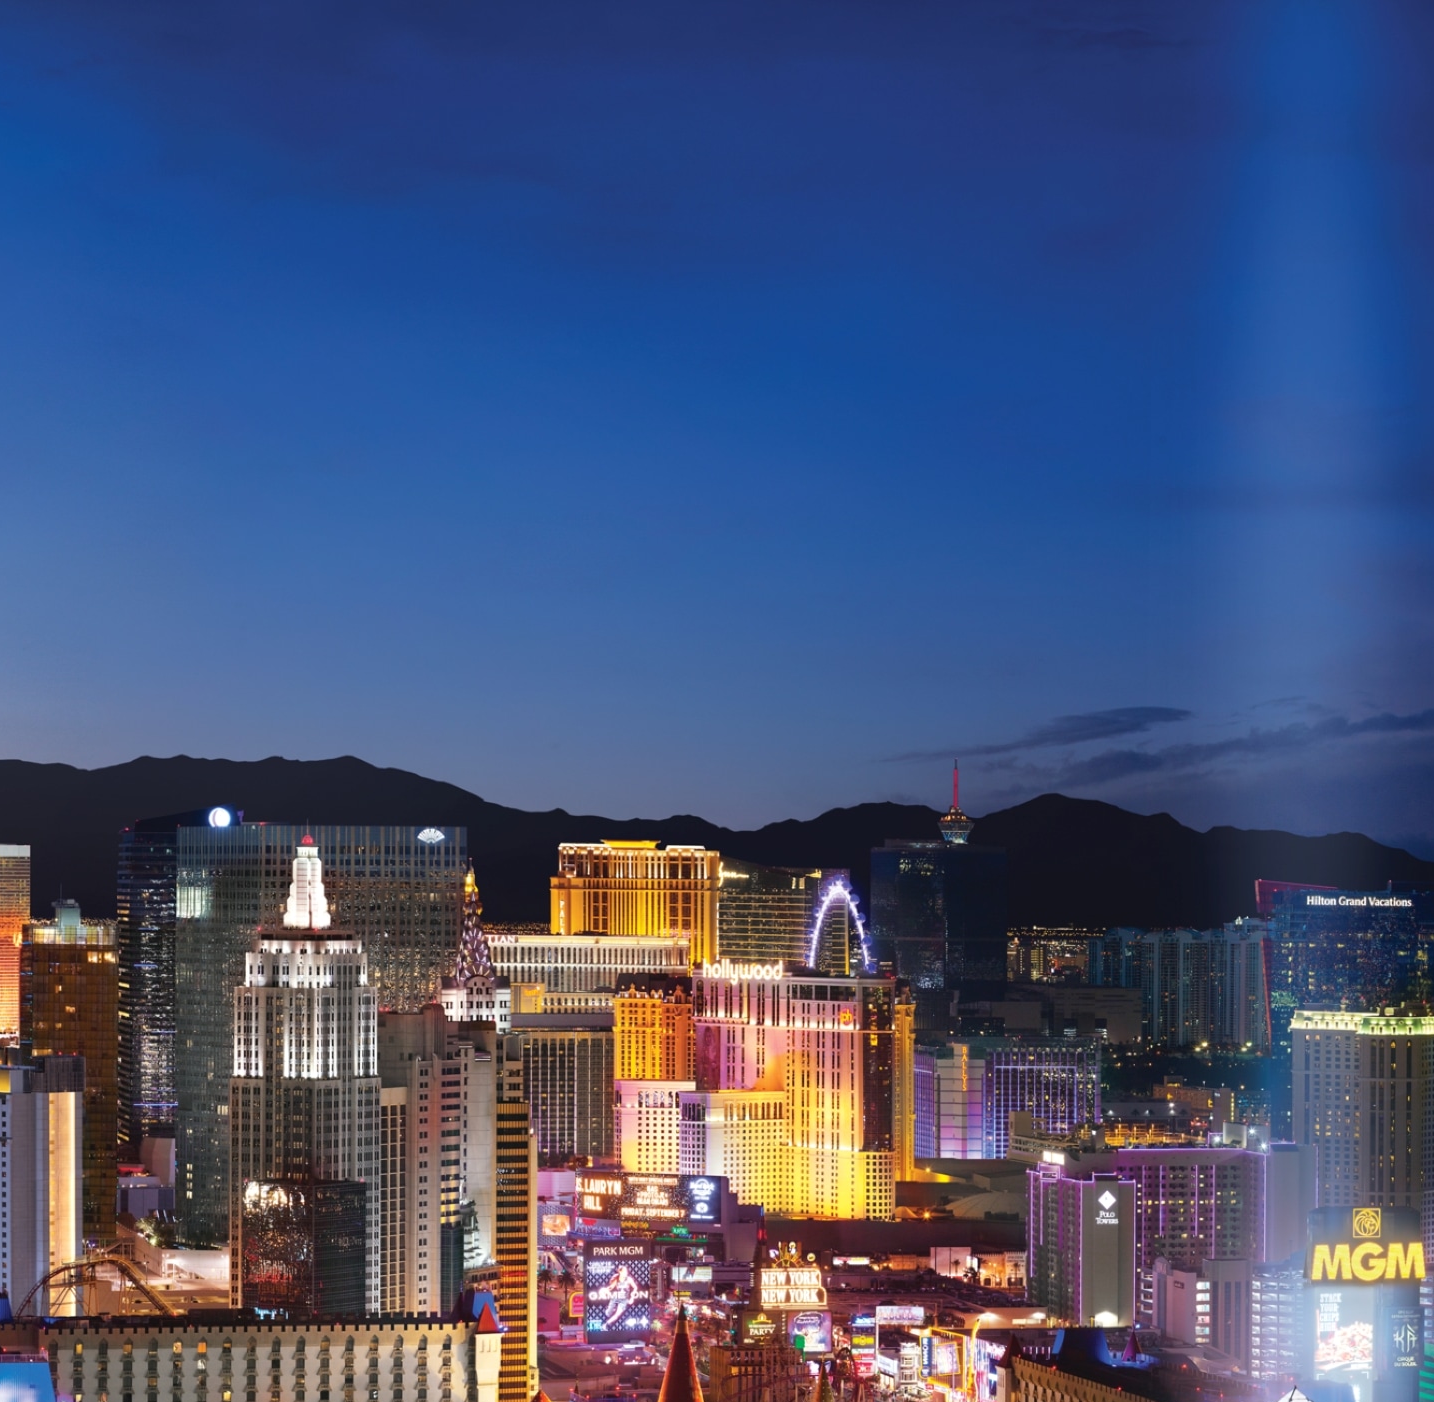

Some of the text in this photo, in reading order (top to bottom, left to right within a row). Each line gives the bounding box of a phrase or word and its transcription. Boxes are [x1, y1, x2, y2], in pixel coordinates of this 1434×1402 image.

[1307, 895, 1413, 907] Hilton Grand Vacations
[702, 958, 784, 985] hollywood
[584, 1178, 622, 1195] LAURYN
[584, 1195, 602, 1211] HILL
[593, 1246, 644, 1256] PARK MGM
[1311, 1242, 1426, 1281] MGM
[761, 1270, 820, 1287] NEW YORK
[588, 1290, 627, 1300] GAME
[631, 1290, 649, 1300] ON
[761, 1288, 819, 1303] NEW YORK
